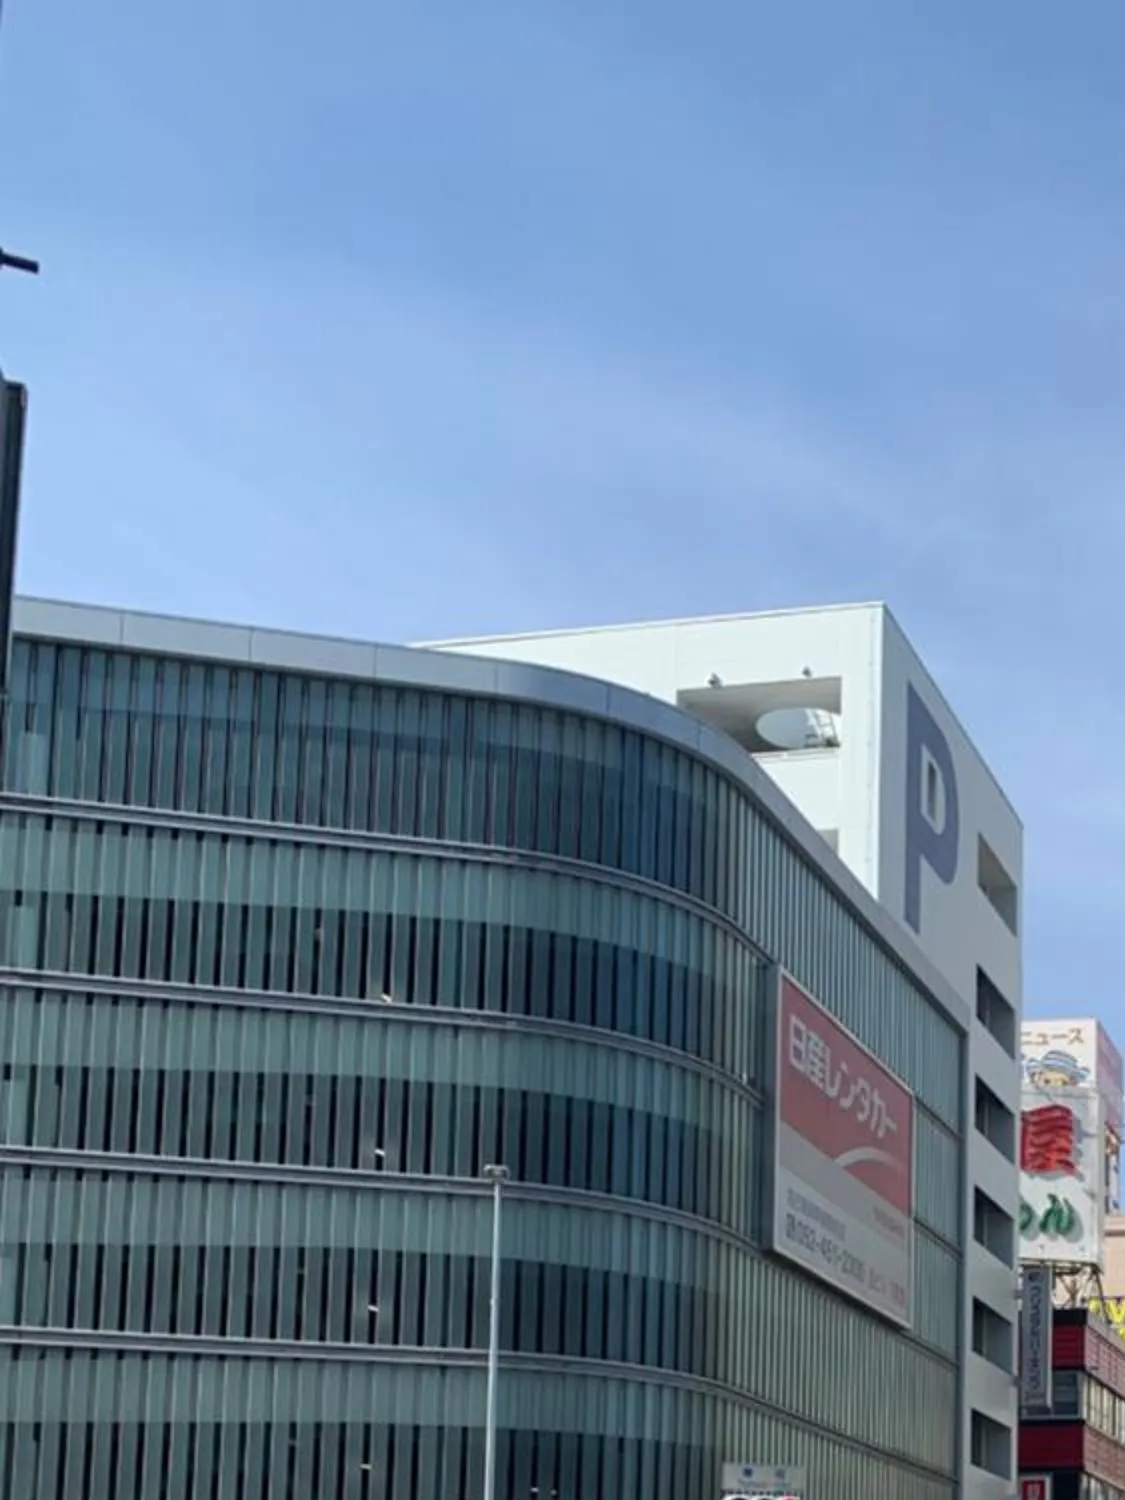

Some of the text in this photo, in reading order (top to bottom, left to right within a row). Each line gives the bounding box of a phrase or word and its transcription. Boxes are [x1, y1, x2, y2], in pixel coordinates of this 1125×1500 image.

[904, 680, 959, 936] P
[788, 1013, 896, 1138] 日産レンタカー
